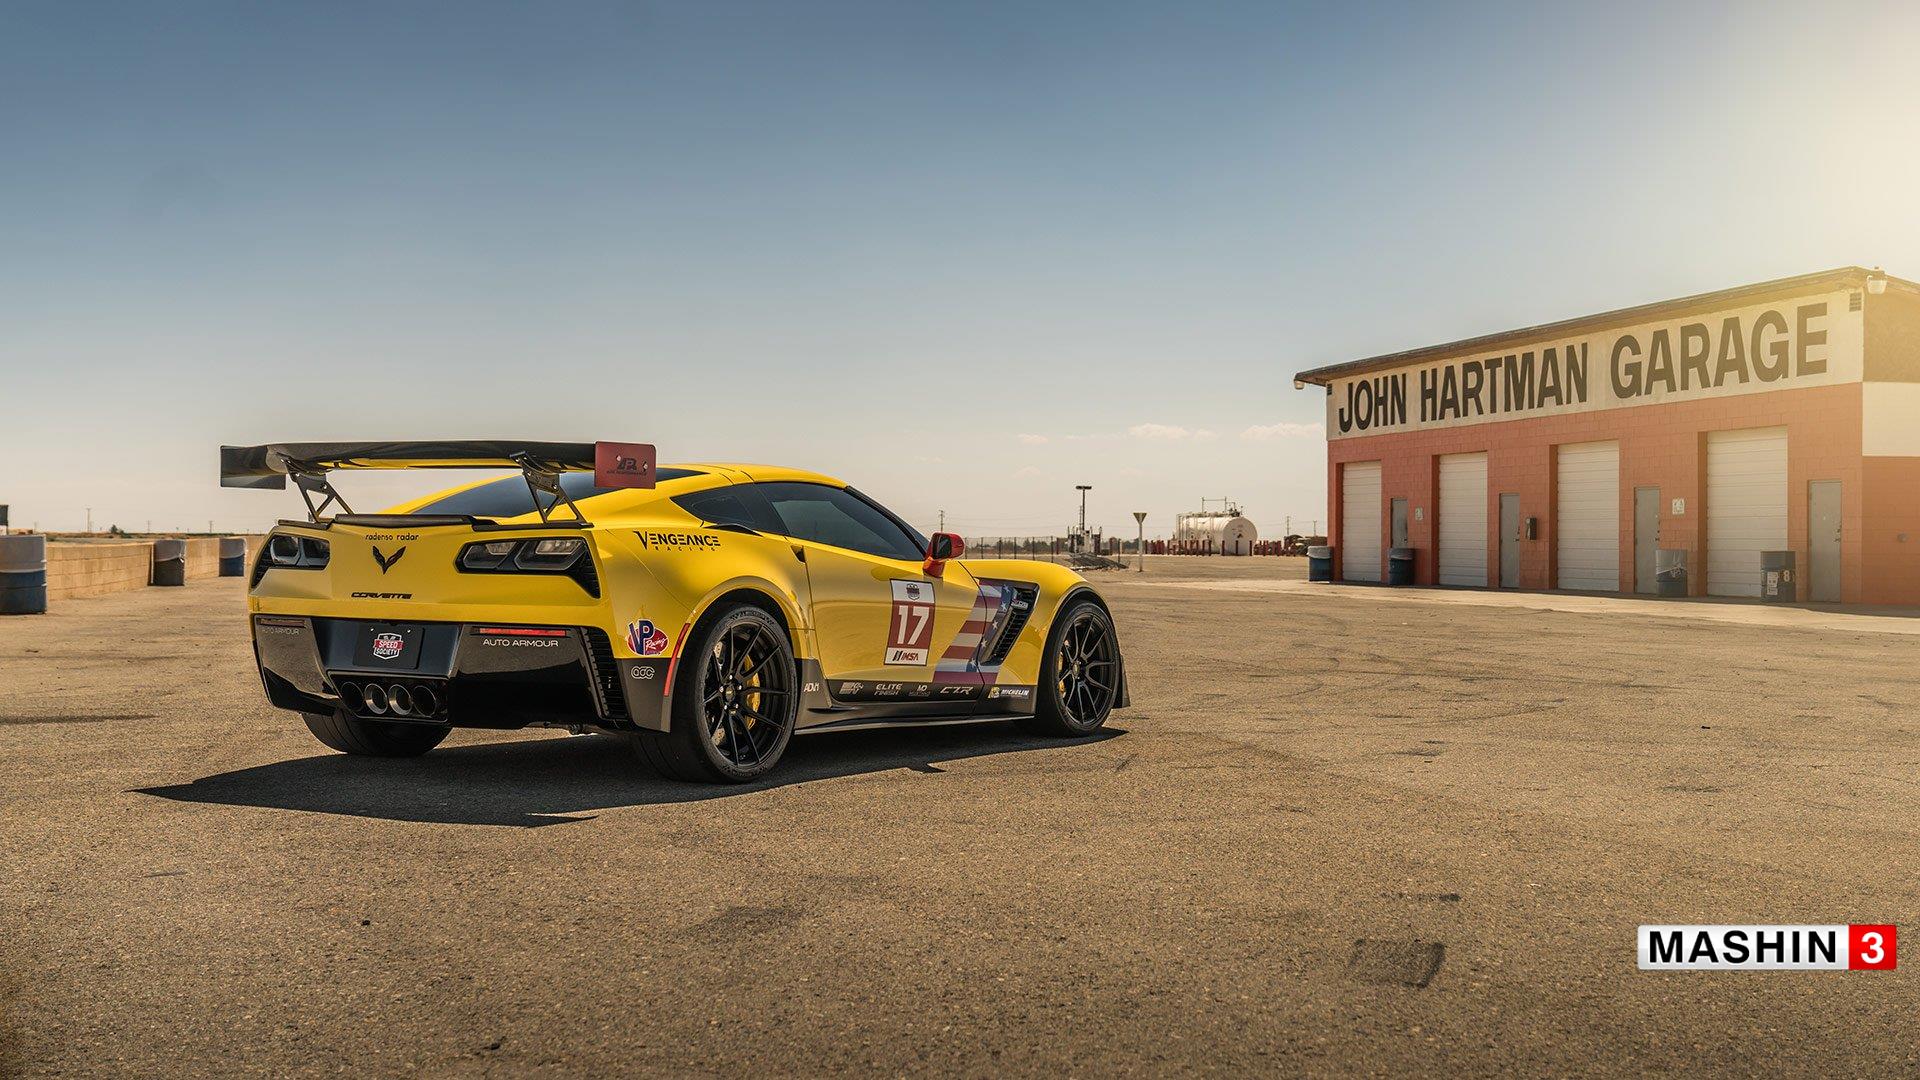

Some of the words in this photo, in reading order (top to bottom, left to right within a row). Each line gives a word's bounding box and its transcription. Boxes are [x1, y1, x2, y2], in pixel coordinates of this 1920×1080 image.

[1339, 373, 1407, 433] JOHN
[1420, 342, 1588, 423] HARTMAN
[1610, 302, 1828, 399] GARAGE
[396, 533, 419, 541] radar
[633, 530, 721, 550] VENGEANCE
[351, 592, 413, 600] CORVETTE
[897, 605, 930, 645] 17
[628, 619, 655, 655] VP
[378, 640, 399, 649] SPEED
[483, 639, 510, 647] AUTO
[512, 639, 559, 648] ARMOUR
[375, 648, 397, 656] SOCIETY
[1001, 688, 1030, 696] MICHELIN
